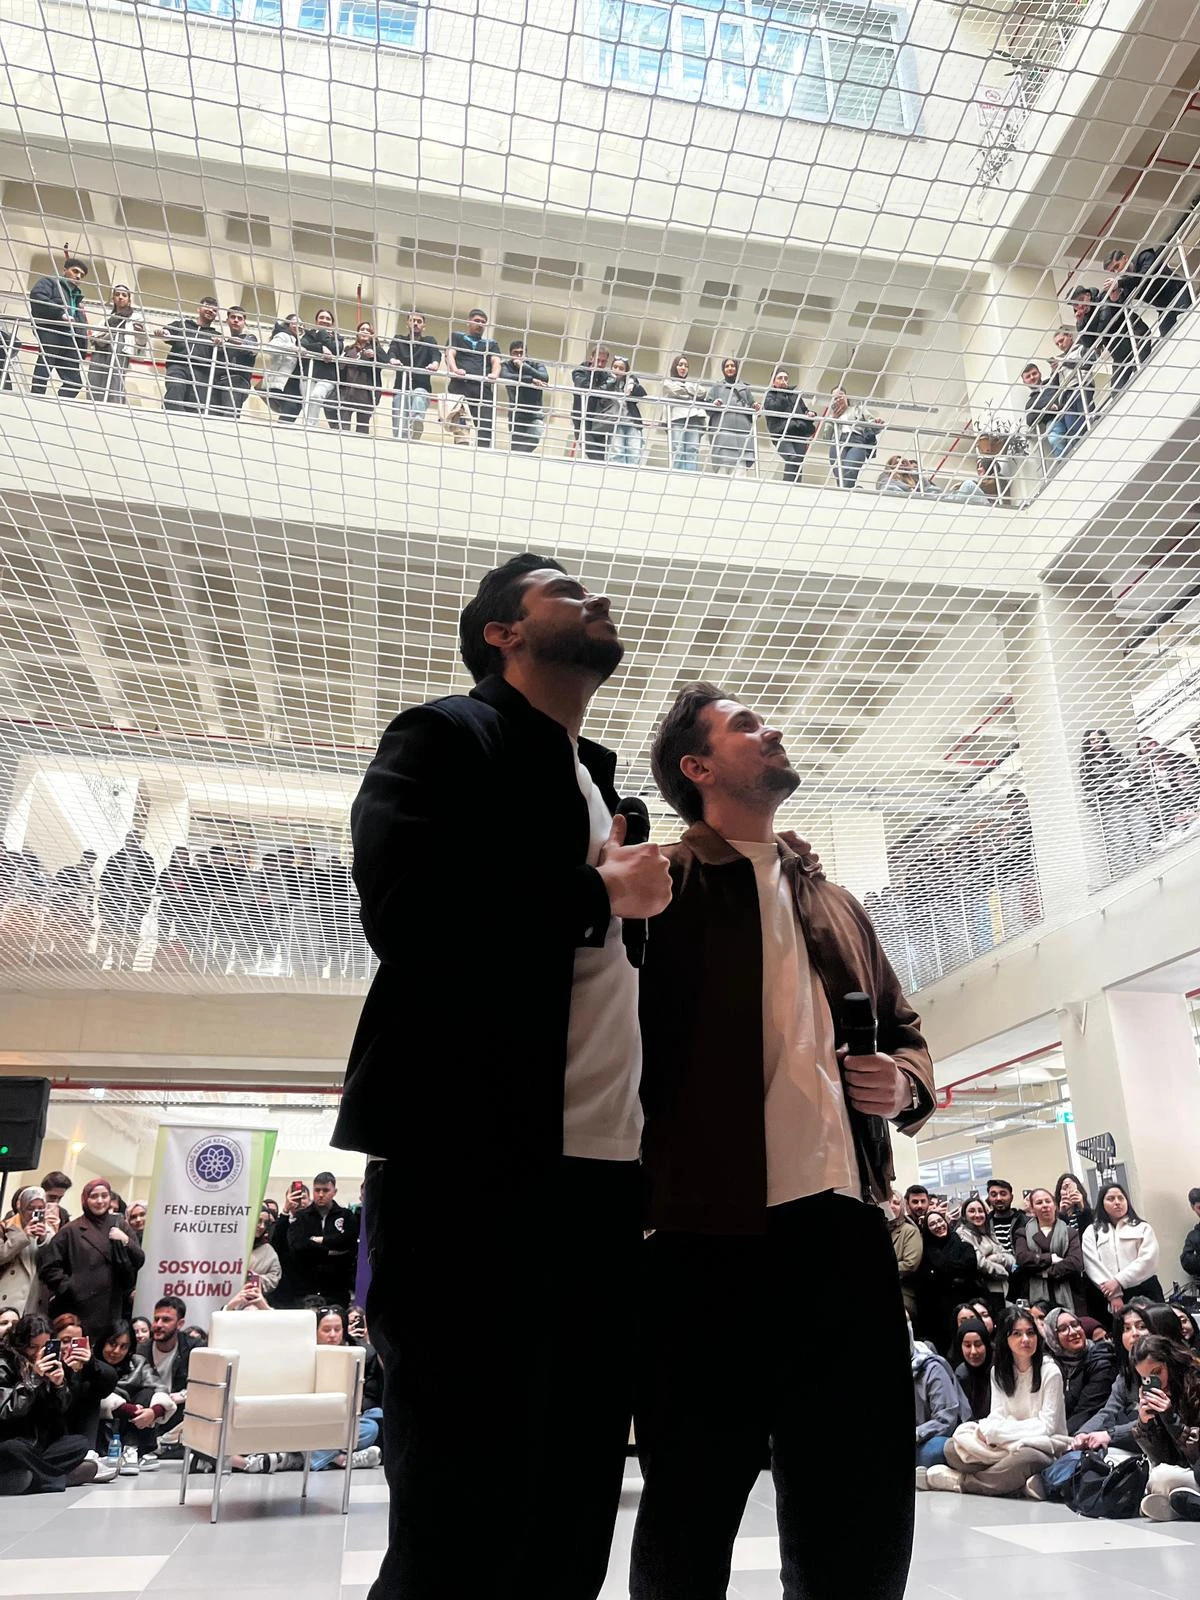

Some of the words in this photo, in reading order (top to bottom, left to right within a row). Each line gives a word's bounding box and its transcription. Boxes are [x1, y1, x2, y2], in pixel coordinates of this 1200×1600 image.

[164, 1203, 252, 1216] FEN-EDEBİYAT
[173, 1220, 238, 1234] FAKÜLTESİ
[158, 1258, 243, 1275] SOSYOLOJİ
[163, 1280, 232, 1297] BÖLÜMÜ
